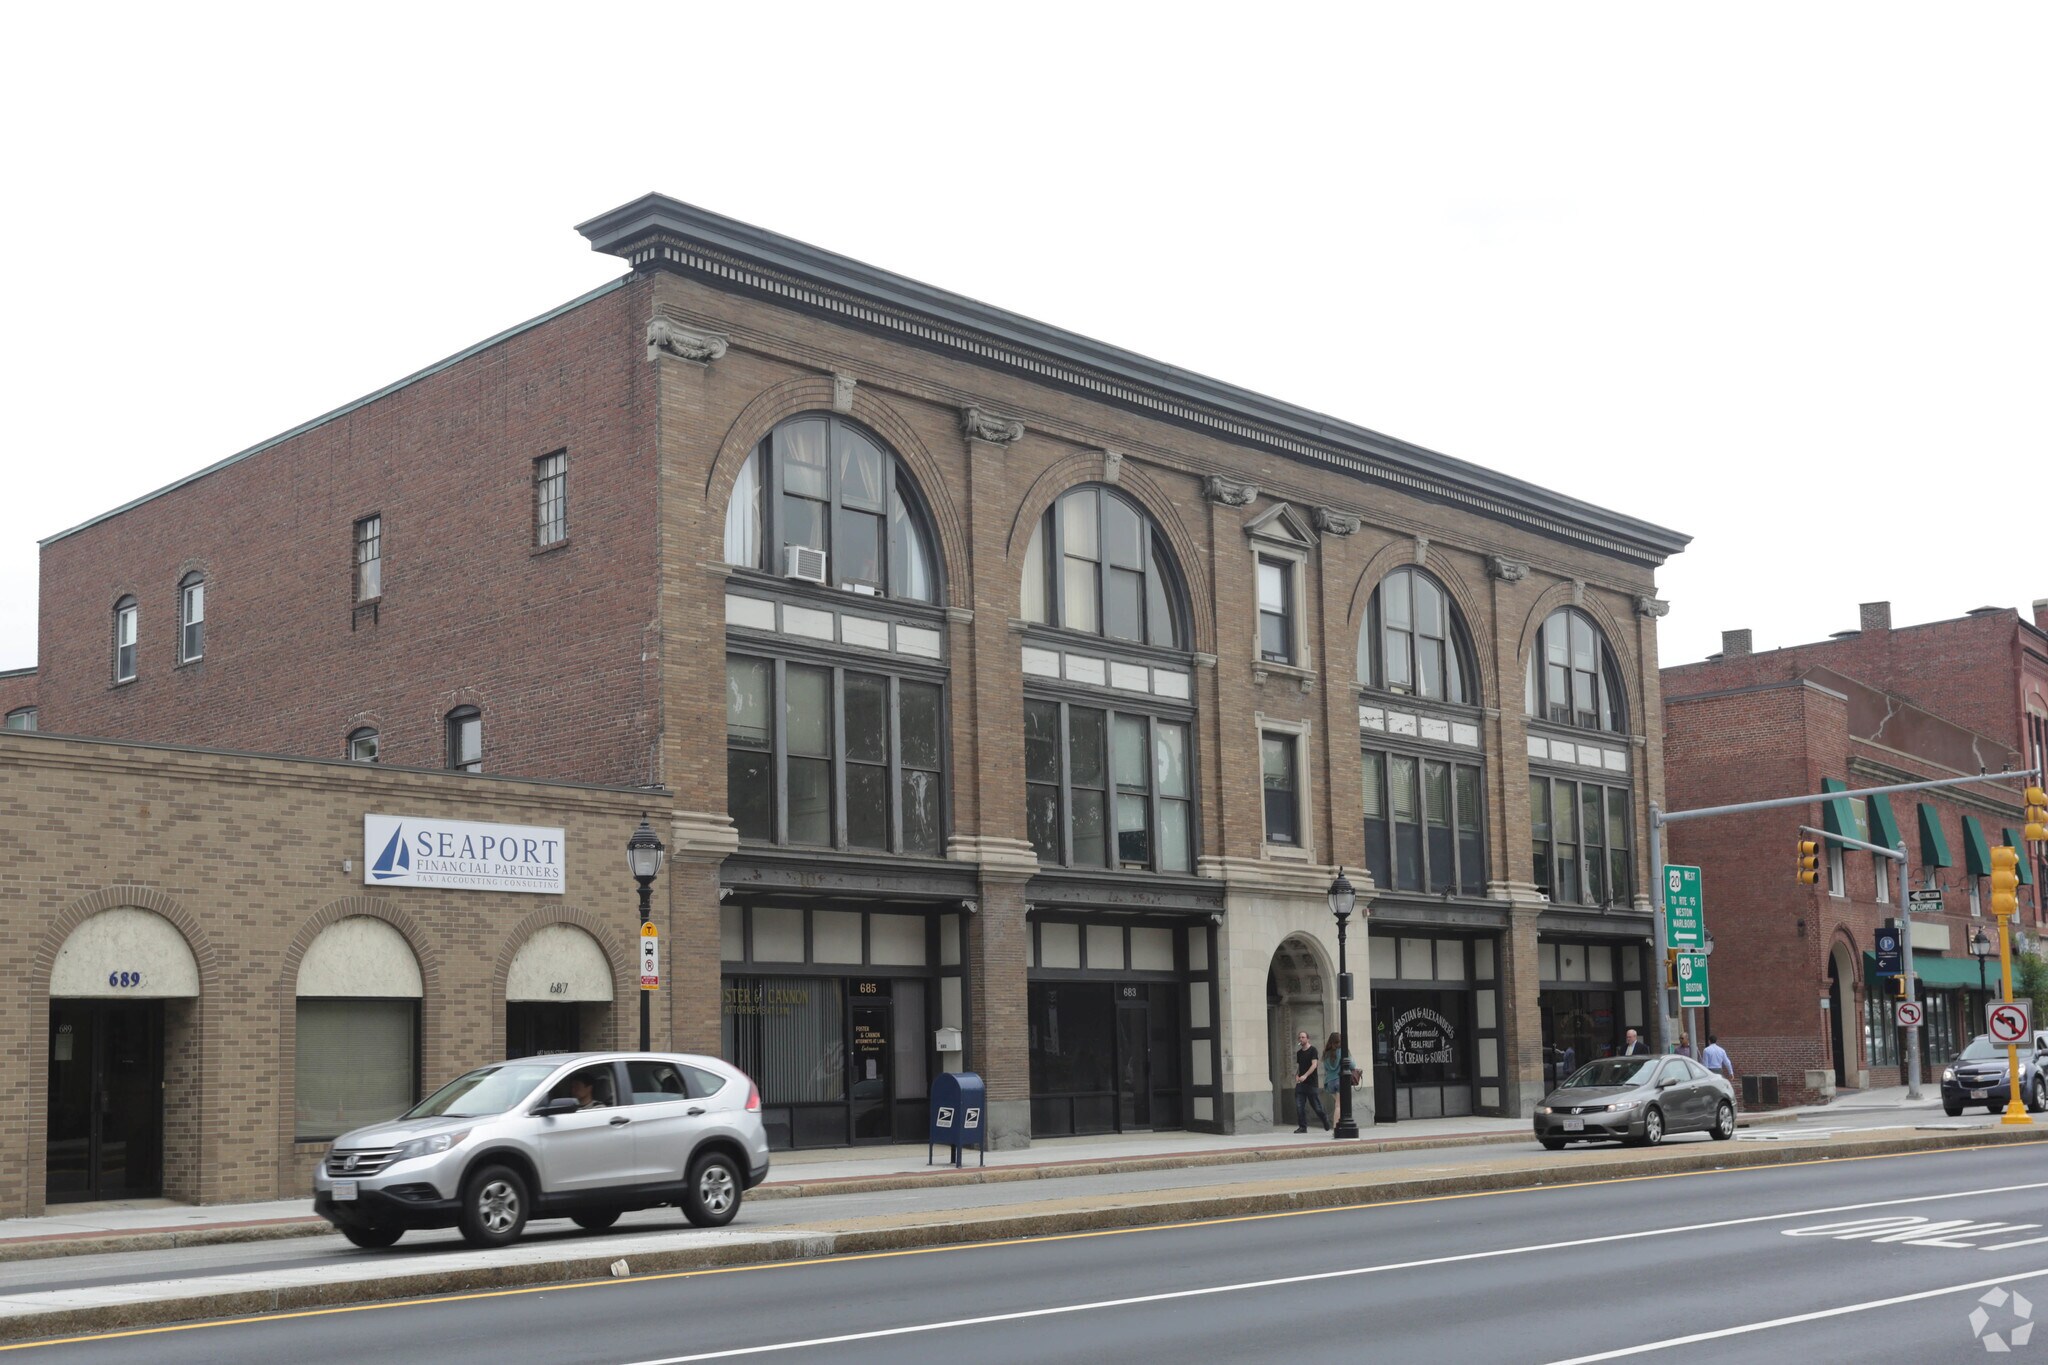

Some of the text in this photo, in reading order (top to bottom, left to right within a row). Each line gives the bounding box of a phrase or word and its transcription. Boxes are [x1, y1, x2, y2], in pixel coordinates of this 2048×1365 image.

[417, 831, 559, 865] SEAPORT
[416, 859, 559, 878] FINANCIAL PARTNERS
[416, 874, 560, 889] TAX ACCOUNTING CONSULTING
[1671, 876, 1680, 888] 20
[1670, 895, 1696, 906] TO RTE 95
[1675, 907, 1693, 917] WESTON
[1916, 903, 1937, 911] COMMON
[1672, 918, 1697, 929] MARLBORO
[1681, 963, 1691, 975] 20
[109, 971, 141, 988] 689
[549, 982, 569, 994] 687
[860, 983, 877, 994] 685
[1123, 987, 1137, 997] 683
[1685, 983, 1703, 993] BOSTON
[767, 989, 809, 1005] CANNON
[1416, 1007, 1422, 1019] &
[59, 1024, 73, 1034] 689
[1404, 1026, 1440, 1038] Homemade
[1404, 1051, 1425, 1064] CREAM
[1424, 1053, 1430, 1064] &
[1430, 1047, 1453, 1064] SORBET
